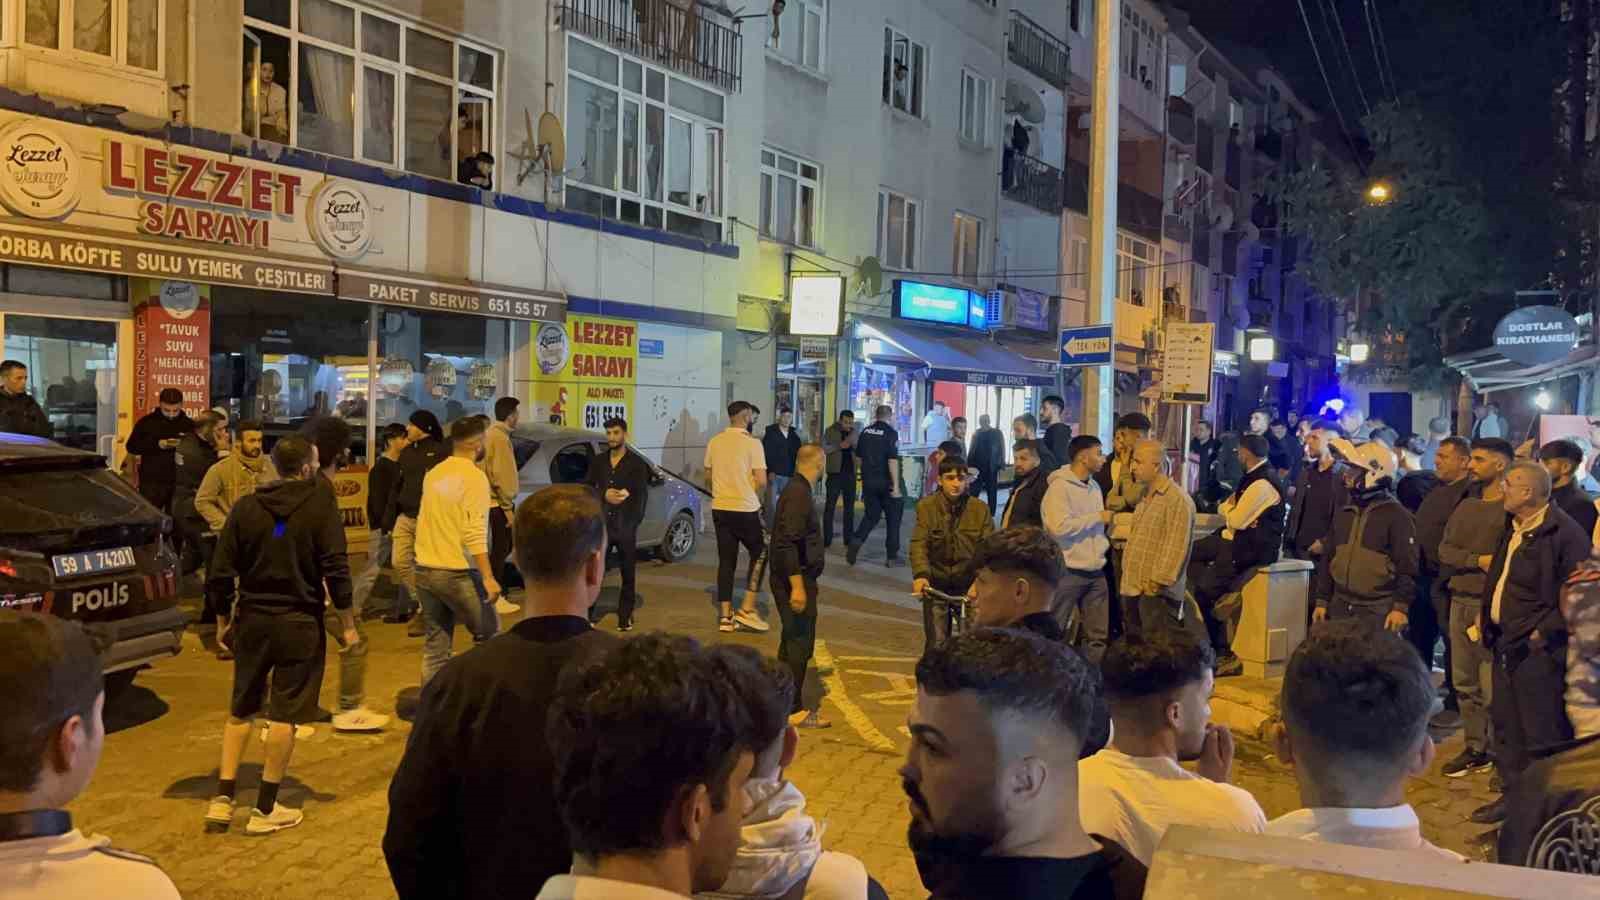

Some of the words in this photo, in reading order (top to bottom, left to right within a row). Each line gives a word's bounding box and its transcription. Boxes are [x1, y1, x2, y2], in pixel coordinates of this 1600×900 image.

[6, 144, 62, 167] Lezzet
[108, 141, 300, 215] LEZZET
[324, 199, 361, 218] Lezzet
[145, 202, 270, 248] SARAYI
[60, 242, 122, 268] KÖFTE
[136, 252, 181, 273] SULU
[187, 258, 243, 280] YEMEK
[369, 283, 420, 303] PAKET
[488, 298, 511, 313] 651
[515, 303, 529, 316] 55
[533, 303, 548, 317] 57
[573, 321, 634, 347] LEZZET
[1508, 321, 1563, 332] DOSTLAR
[165, 340, 193, 352] SUYU
[1497, 333, 1575, 345] KIRATHANESİ
[573, 354, 633, 378] SARAYI
[184, 375, 205, 389] PAÇA
[996, 375, 1029, 386] MARKET
[586, 405, 600, 428] 651
[61, 556, 78, 573] 59
[84, 555, 93, 571] A
[96, 549, 133, 569] 74201
